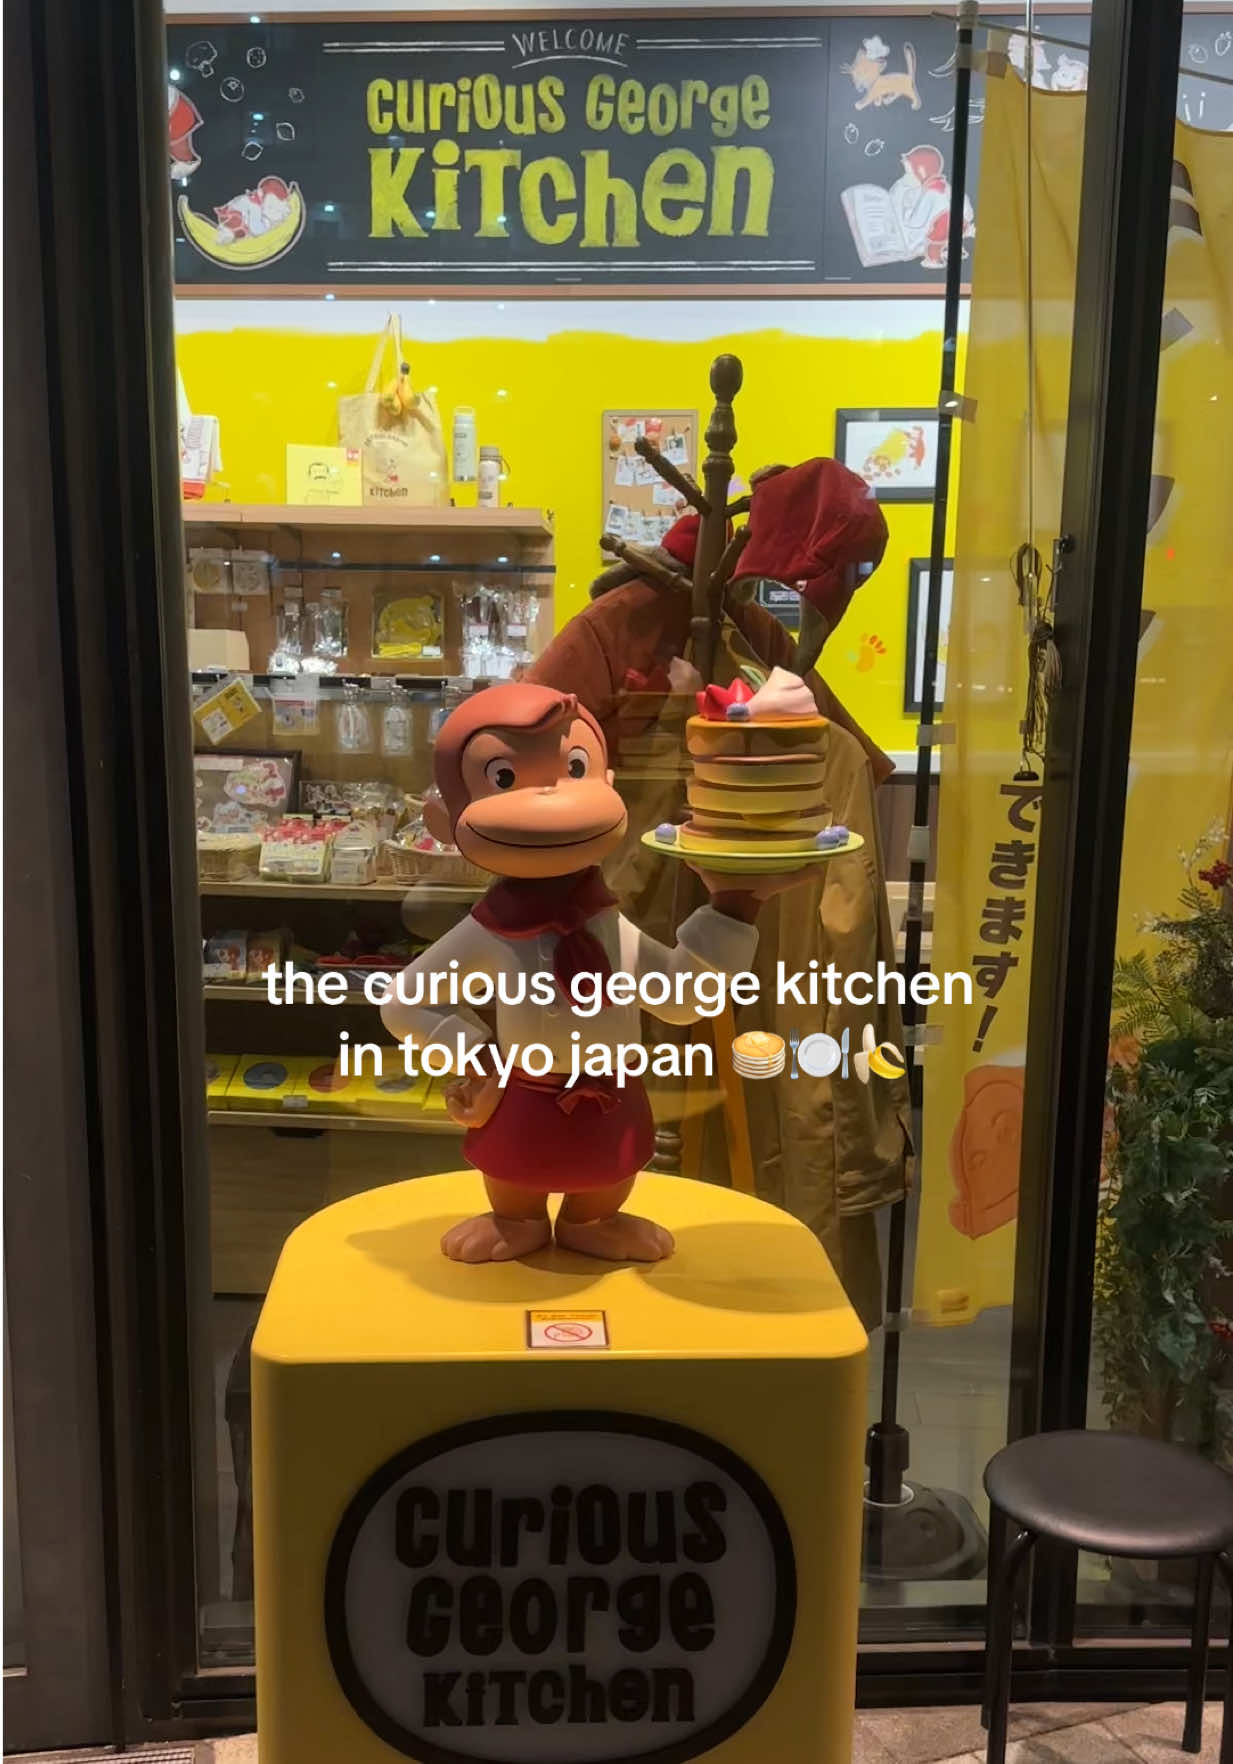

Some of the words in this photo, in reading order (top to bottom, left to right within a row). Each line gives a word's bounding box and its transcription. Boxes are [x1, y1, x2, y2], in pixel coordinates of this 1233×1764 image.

[512, 30, 632, 58] WELCOME
[367, 74, 566, 135] Curious
[586, 75, 772, 137] George
[395, 1481, 728, 1569] Curious
[405, 1571, 716, 1658] George
